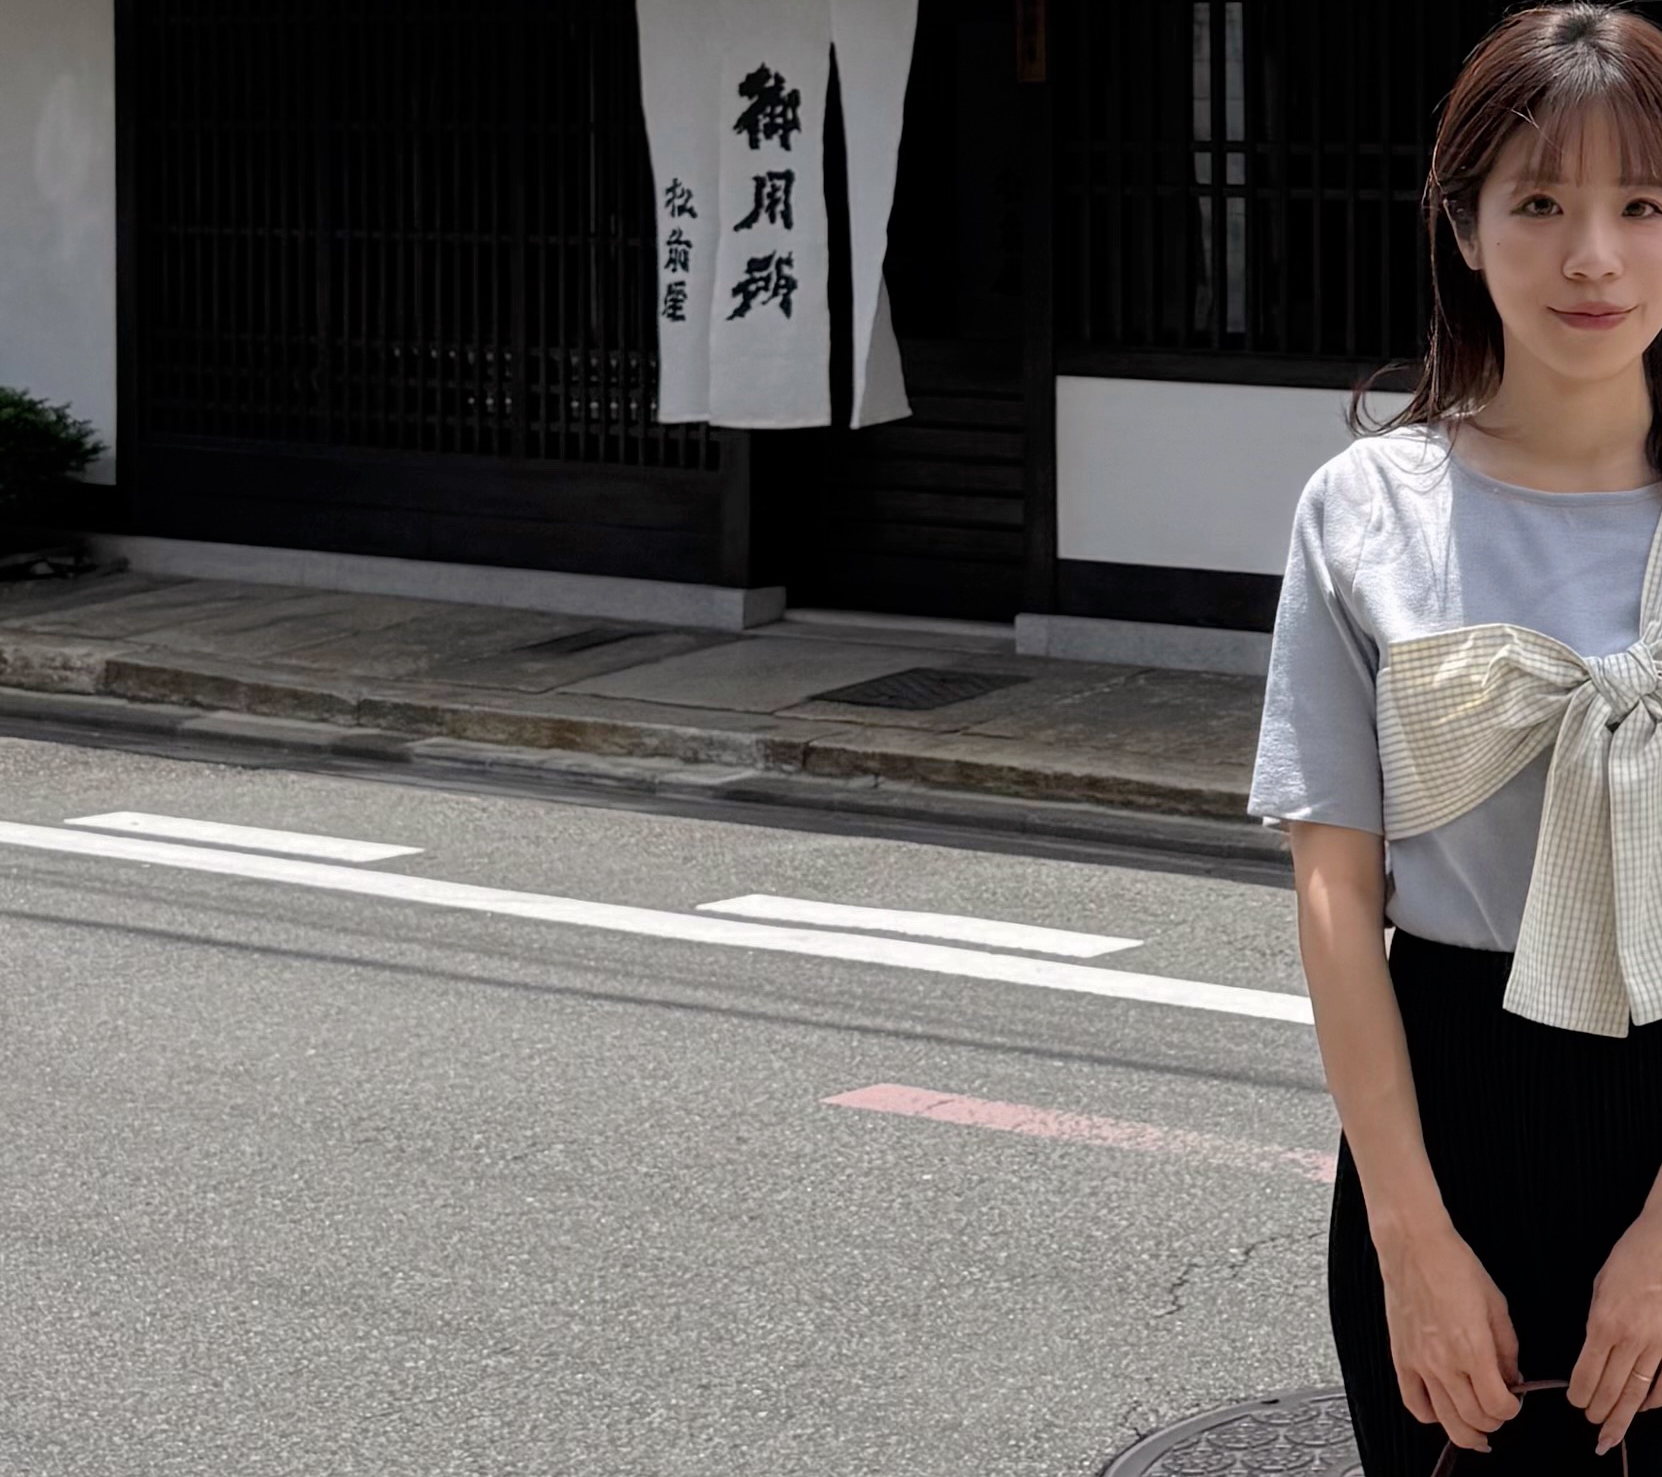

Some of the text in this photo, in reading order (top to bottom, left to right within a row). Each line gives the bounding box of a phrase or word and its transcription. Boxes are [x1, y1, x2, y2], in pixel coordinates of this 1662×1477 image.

[662, 177, 698, 322] 松前屋
[726, 62, 801, 321] 御用所
